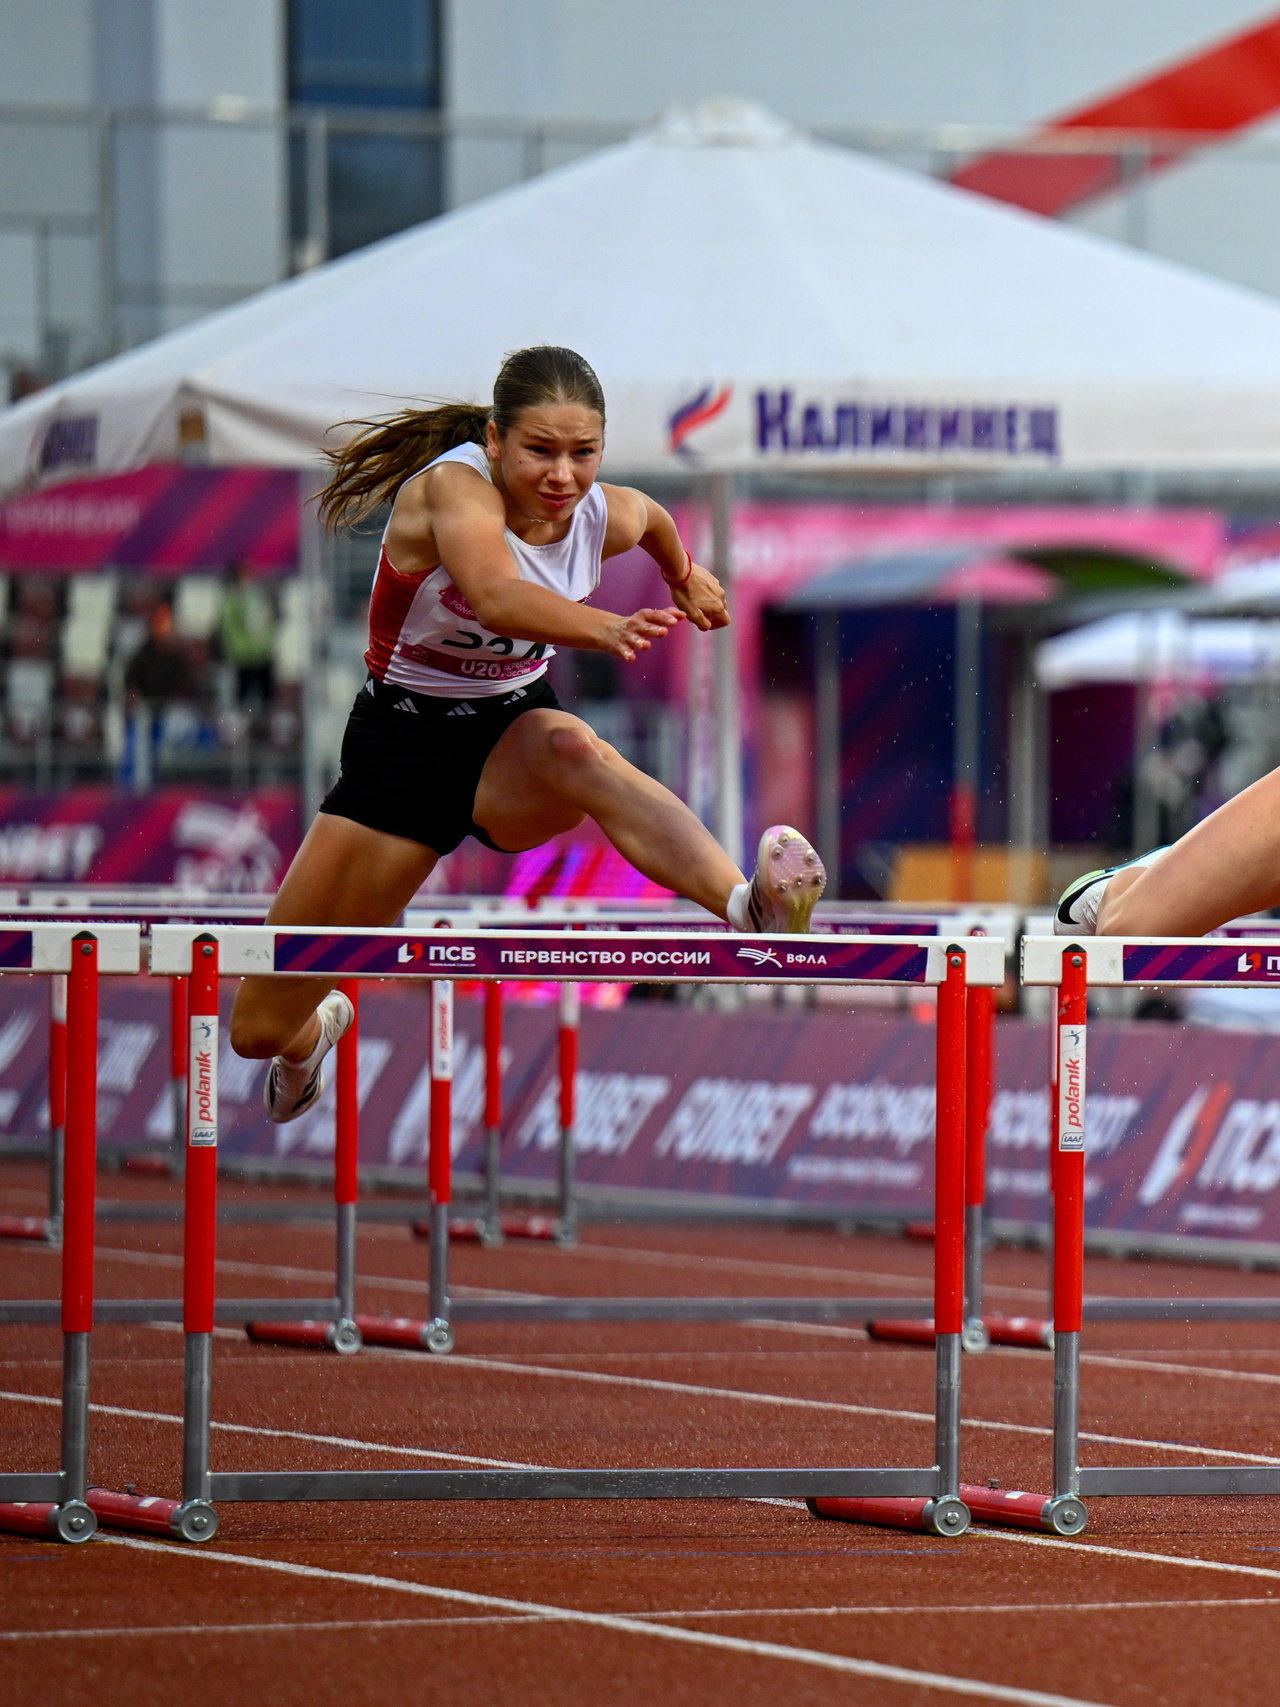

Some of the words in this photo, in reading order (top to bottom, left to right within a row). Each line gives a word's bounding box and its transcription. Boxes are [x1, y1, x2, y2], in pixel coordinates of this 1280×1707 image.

[460, 660, 501, 678] U20
[429, 945, 476, 961] ПСБ
[500, 950, 625, 964] ПЕРВЕНСТВО
[631, 951, 711, 965] РОССИИ
[786, 953, 827, 965] ВФЛА
[195, 1050, 214, 1123] polanik
[1065, 1057, 1083, 1128] polanik
